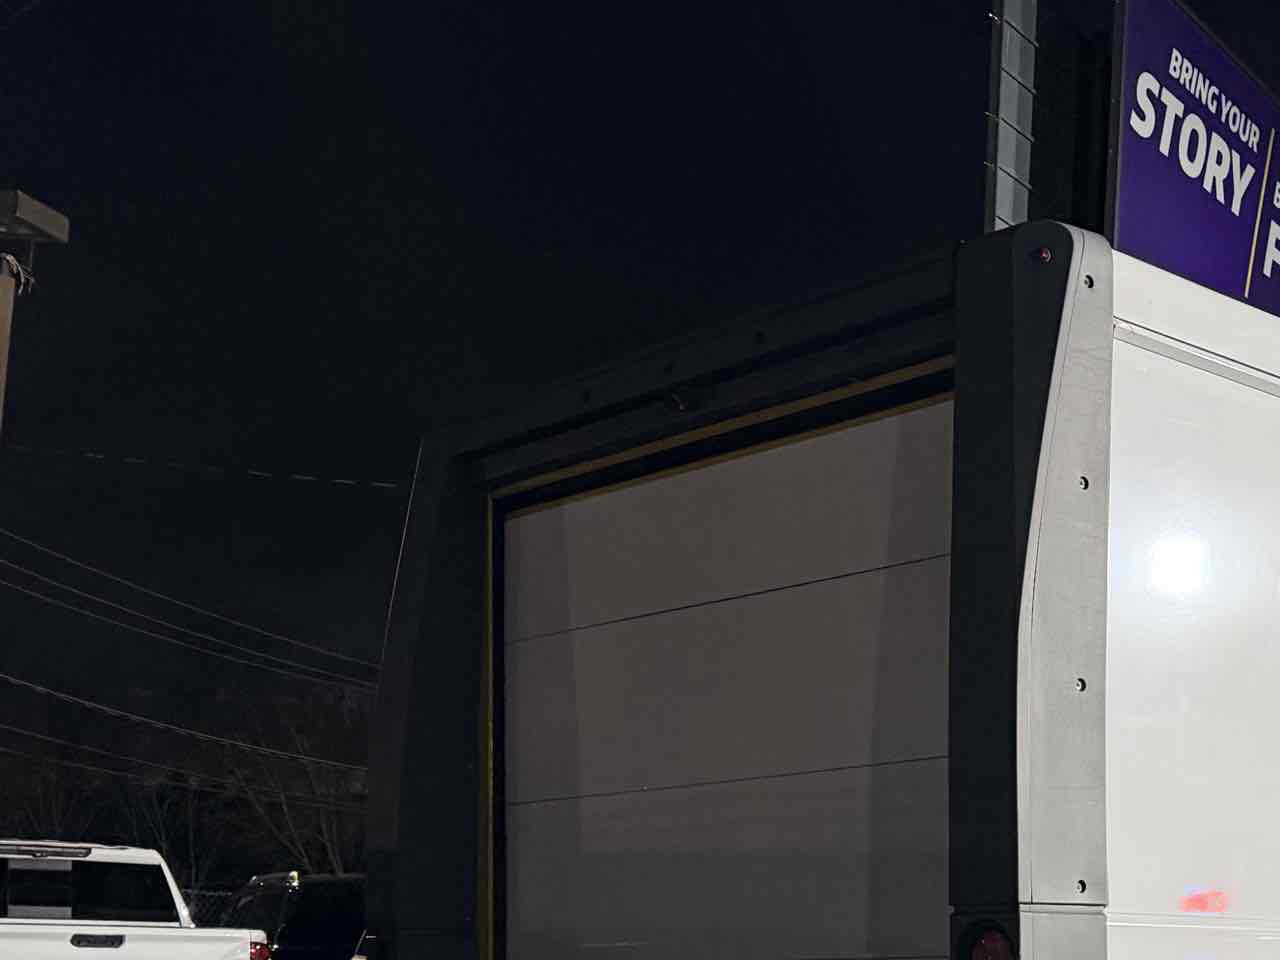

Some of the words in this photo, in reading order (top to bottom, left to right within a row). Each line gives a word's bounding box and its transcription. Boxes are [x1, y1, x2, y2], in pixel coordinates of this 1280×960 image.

[1130, 71, 1256, 217] STORY
[1169, 48, 1219, 113] BRING
[1221, 96, 1261, 152] YOUR
